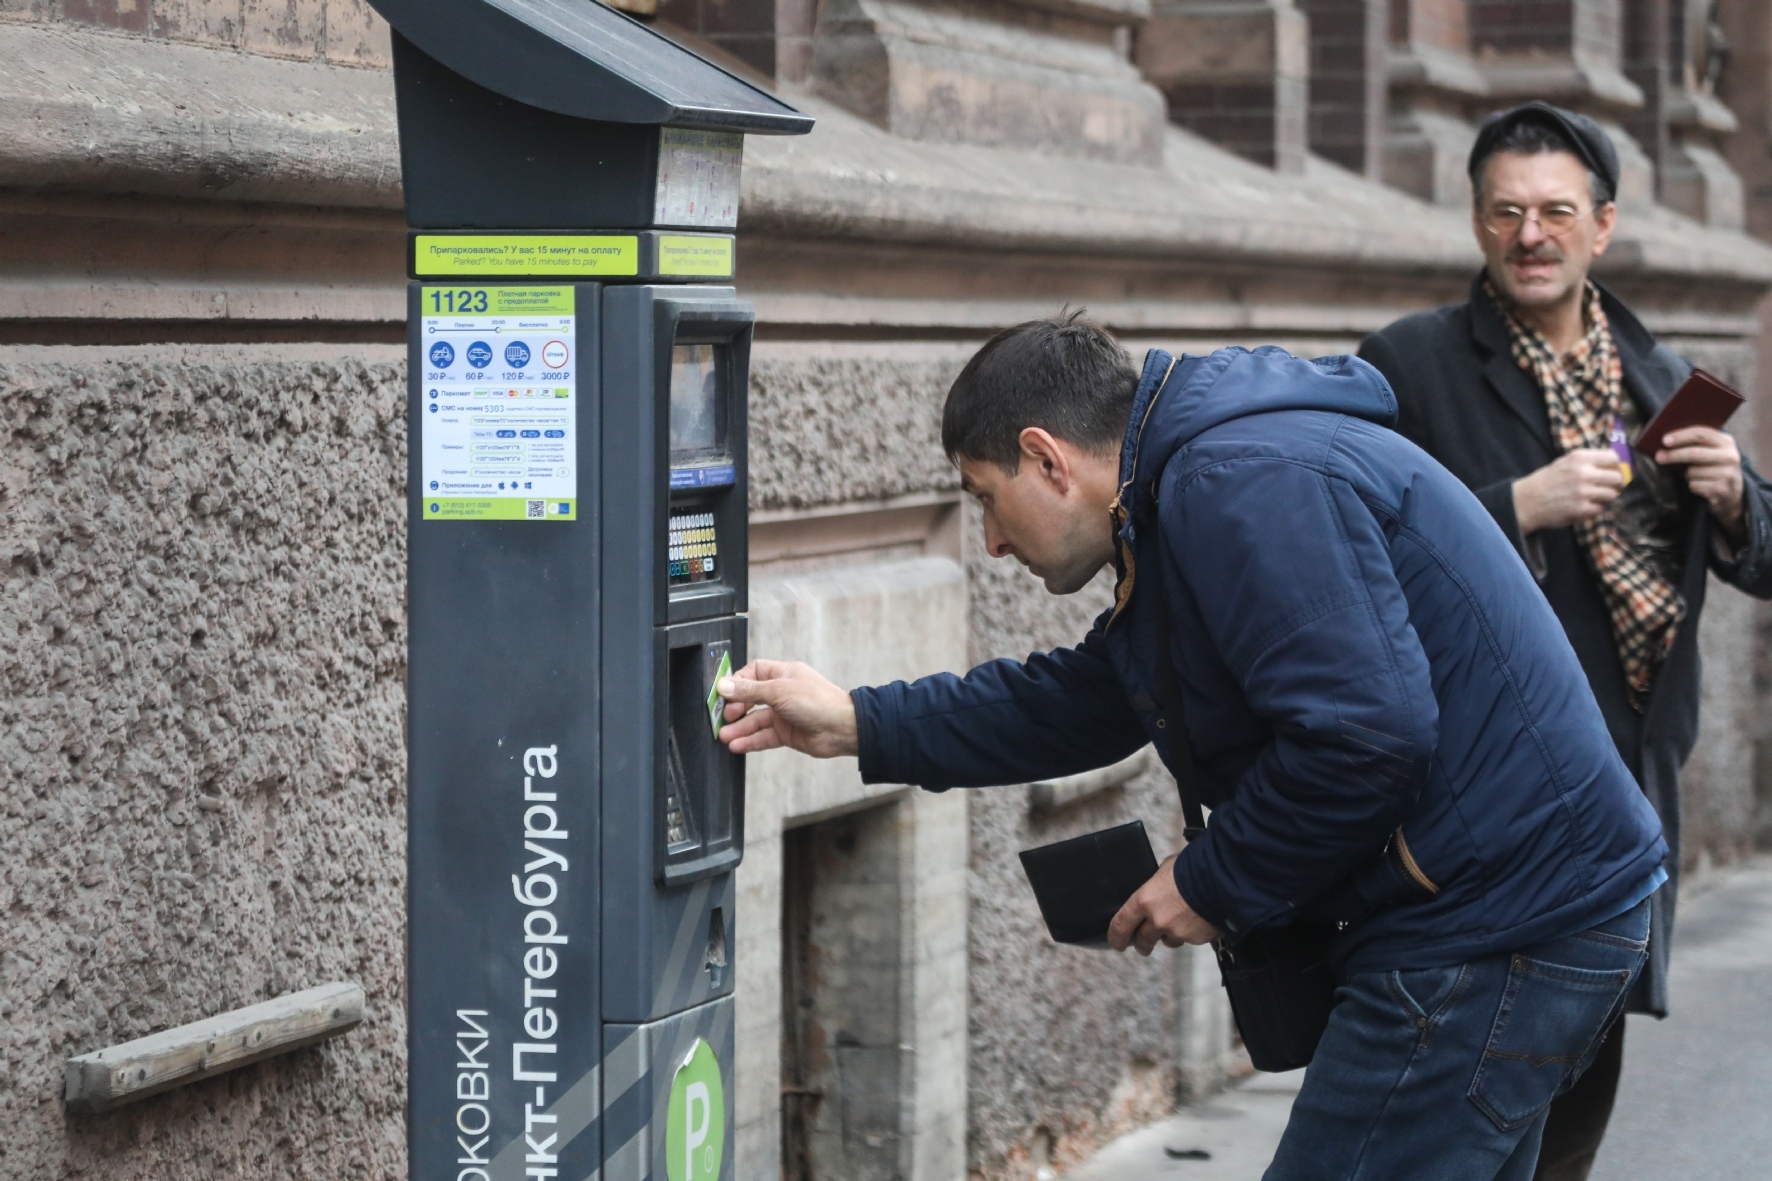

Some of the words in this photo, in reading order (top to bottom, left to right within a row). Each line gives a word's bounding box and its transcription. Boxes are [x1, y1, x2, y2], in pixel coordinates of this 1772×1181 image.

[430, 246, 508, 256] Припарковались?
[538, 246, 547, 254] 15
[550, 248, 575, 256] минут
[591, 248, 621, 256] оплату
[453, 257, 486, 266] Parked?
[489, 258, 502, 266] You
[505, 258, 524, 266] have
[527, 258, 536, 266] 15
[539, 257, 570, 266] minutes
[572, 258, 580, 266] to
[498, 290, 526, 298] Платная
[431, 290, 488, 313] 1123
[484, 405, 504, 413] 5303
[686, 1081, 711, 1181] P
